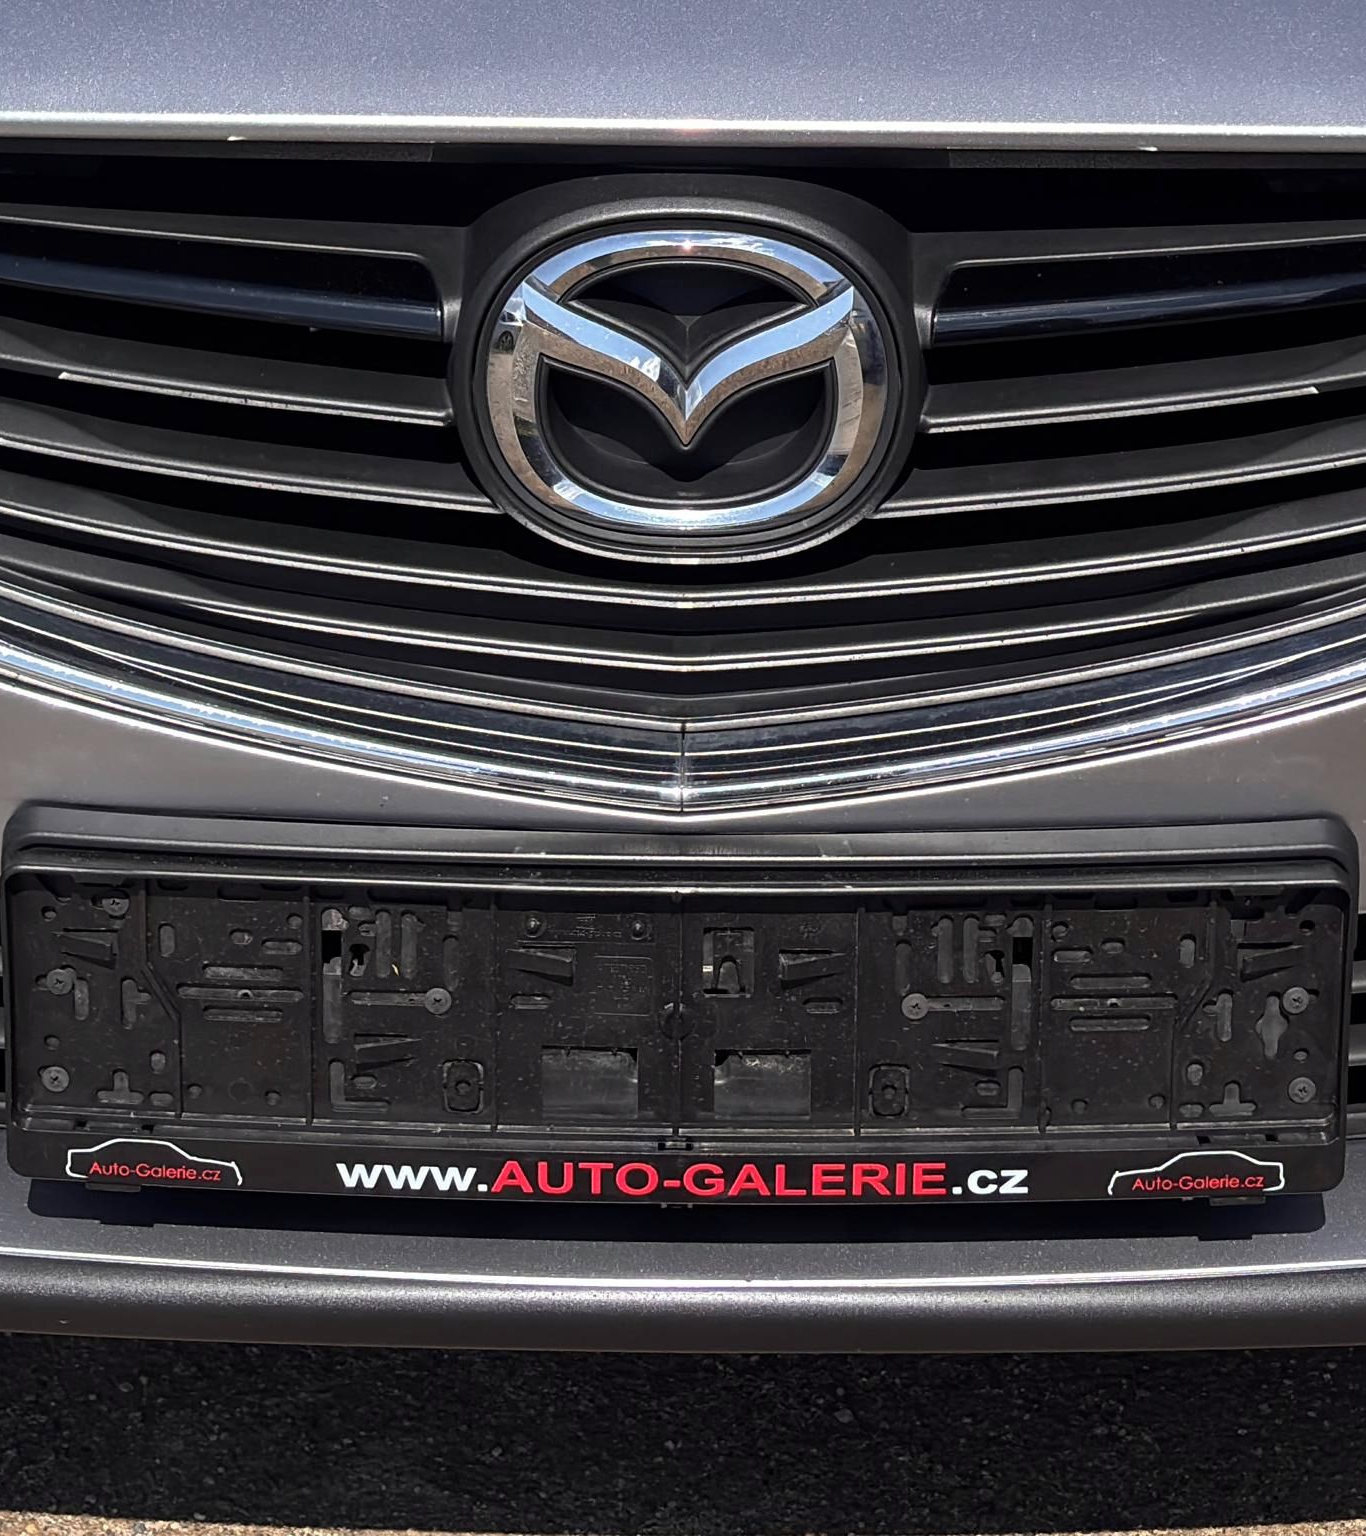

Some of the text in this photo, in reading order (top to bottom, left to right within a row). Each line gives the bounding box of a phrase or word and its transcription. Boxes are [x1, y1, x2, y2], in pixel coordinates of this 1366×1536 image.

[89, 1162, 221, 1181] Auto-Galerie.cz
[336, 1159, 1029, 1197] www.AUTO-GALERIE.cz
[1132, 1175, 1265, 1192] Auto-Galerie.cz
